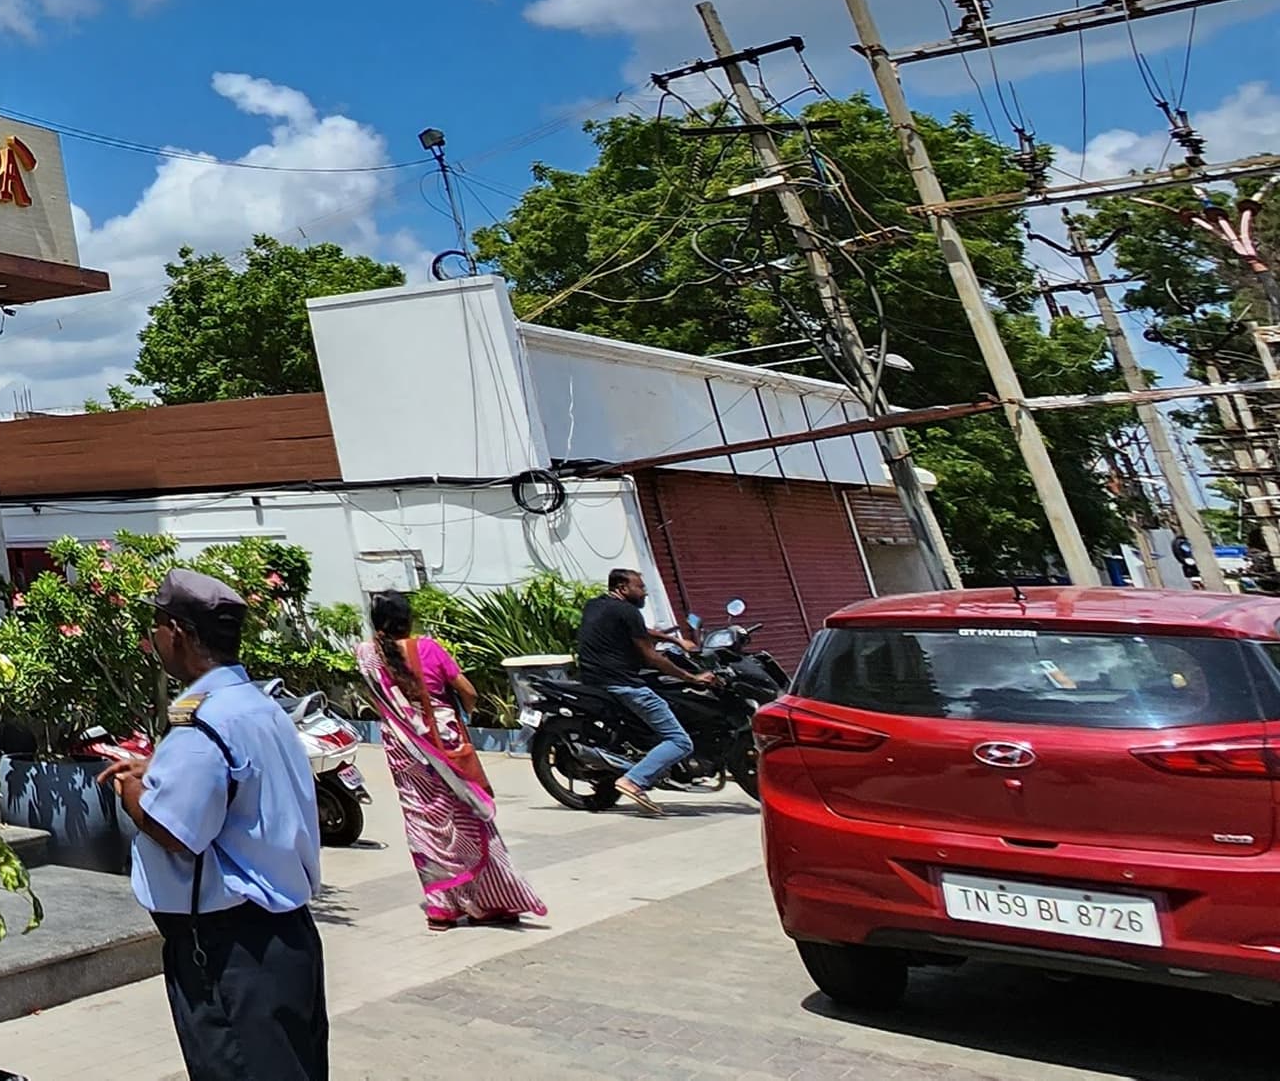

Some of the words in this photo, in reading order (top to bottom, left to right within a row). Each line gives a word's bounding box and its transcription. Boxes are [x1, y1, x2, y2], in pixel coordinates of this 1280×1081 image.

[959, 888, 991, 913] TN
[997, 893, 1028, 917] 59
[1037, 899, 1069, 924] BL
[1076, 904, 1144, 933] 8726
